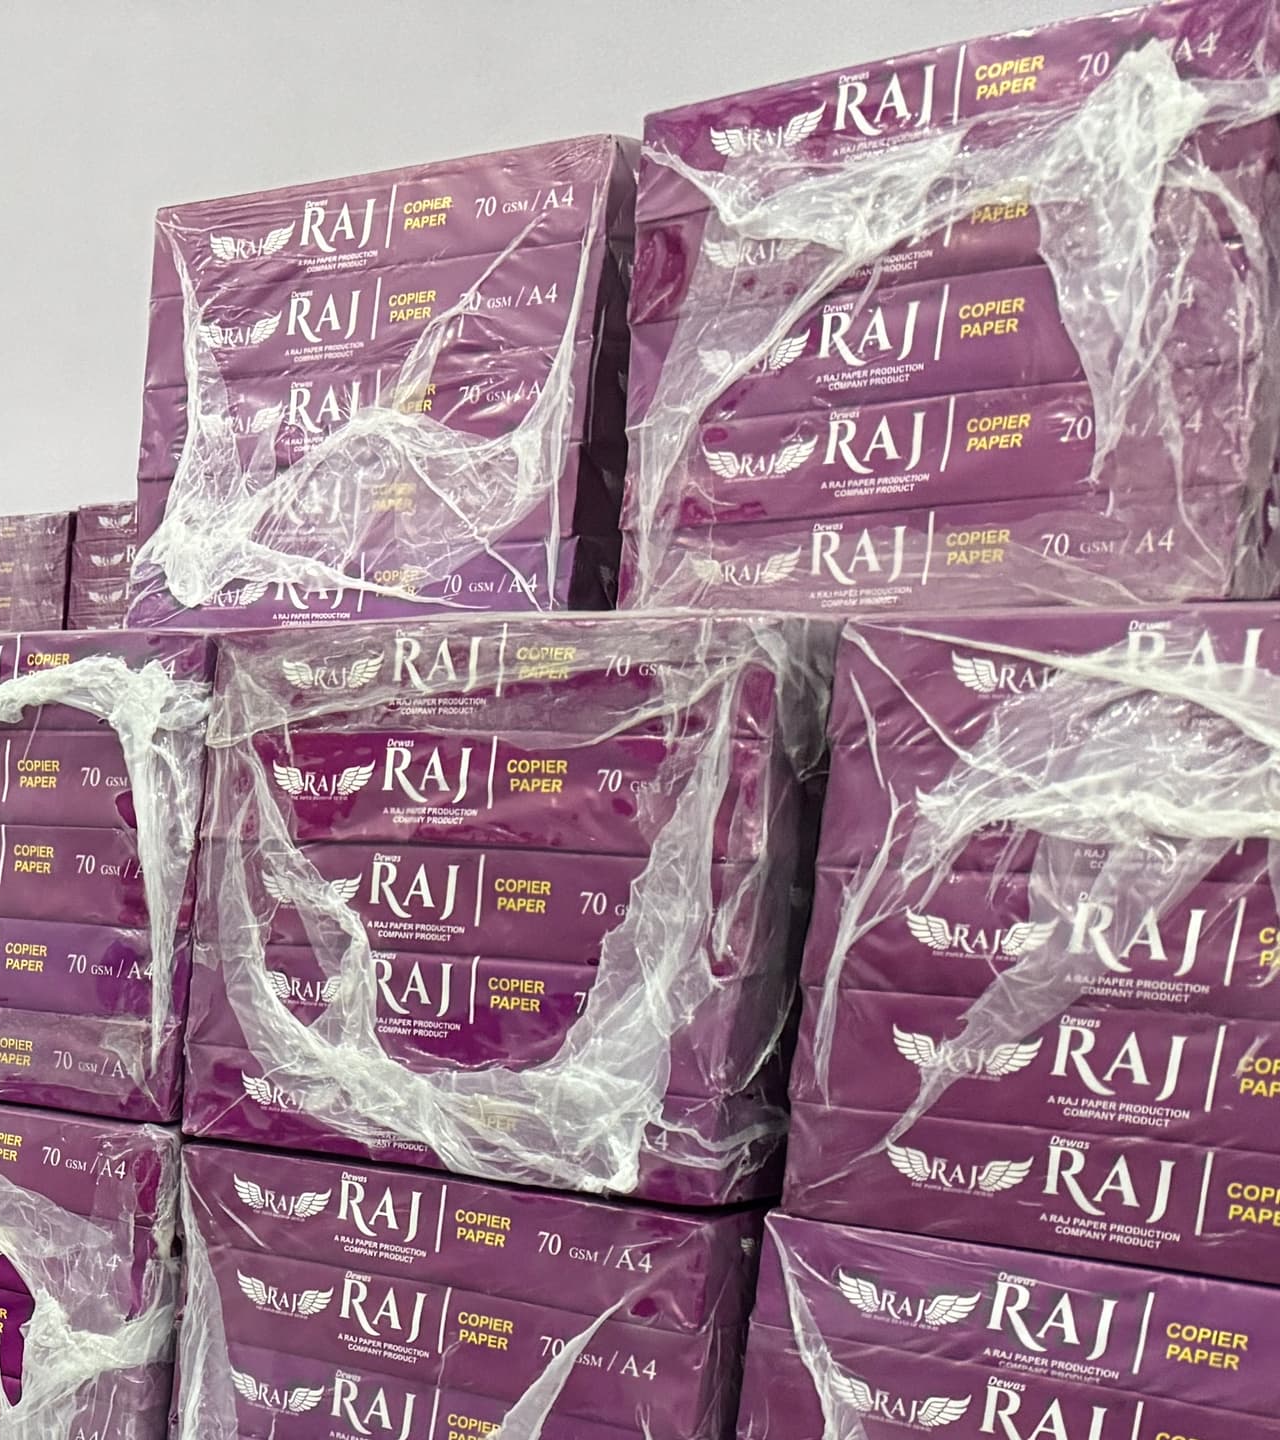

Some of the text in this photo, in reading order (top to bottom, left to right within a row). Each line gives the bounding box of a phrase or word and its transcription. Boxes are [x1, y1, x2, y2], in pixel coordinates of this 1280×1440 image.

[975, 55, 1044, 82] COPIER
[1077, 52, 1109, 77] 70
[833, 63, 936, 136] RAJ
[976, 76, 1036, 100] PAPER
[403, 196, 452, 216] COPIER
[474, 196, 498, 218] 70
[502, 200, 528, 214] GSM
[299, 199, 376, 252] RAJ
[404, 212, 446, 230] PAPER
[286, 289, 362, 340] RAJ
[818, 301, 920, 368] RAJ
[967, 413, 1031, 434] COPIER
[1061, 417, 1093, 442] 70
[822, 412, 926, 474] RAJ
[967, 432, 1023, 452] PAPER
[829, 480, 846, 488] RAJ
[848, 478, 876, 487] PAPER
[877, 474, 930, 484] PRODUCTION
[834, 484, 914, 497] COMPANY PRODUCT
[17, 760, 60, 773] COPIER
[80, 766, 101, 787] 70
[382, 739, 472, 803] RAJ
[506, 758, 568, 776] COPIER
[19, 775, 57, 789] PAPER
[509, 776, 563, 793] PAPER
[596, 768, 623, 792] 70
[5, 942, 47, 957] COPIER
[5, 957, 44, 972] PAPER
[67, 954, 114, 976] 70 GSM
[1051, 1025, 1188, 1101] RAJ
[1050, 1136, 1090, 1150] Dewas
[40, 1145, 61, 1166] 70
[65, 1158, 87, 1172] GSM
[930, 1158, 985, 1191] RAJ
[1042, 1146, 1176, 1223] RAJ
[264, 1190, 297, 1214] RAJ
[336, 1178, 422, 1243] RAJ
[455, 1208, 511, 1231] COPIER
[1040, 1213, 1180, 1241] A RAJ PAPER PRODUCTION
[455, 1227, 506, 1248] PAPER
[536, 1231, 561, 1256] 70
[568, 1246, 599, 1261] GSM
[1055, 1226, 1161, 1249] COMPANY PRODUCT
[878, 1291, 925, 1324] RAJ
